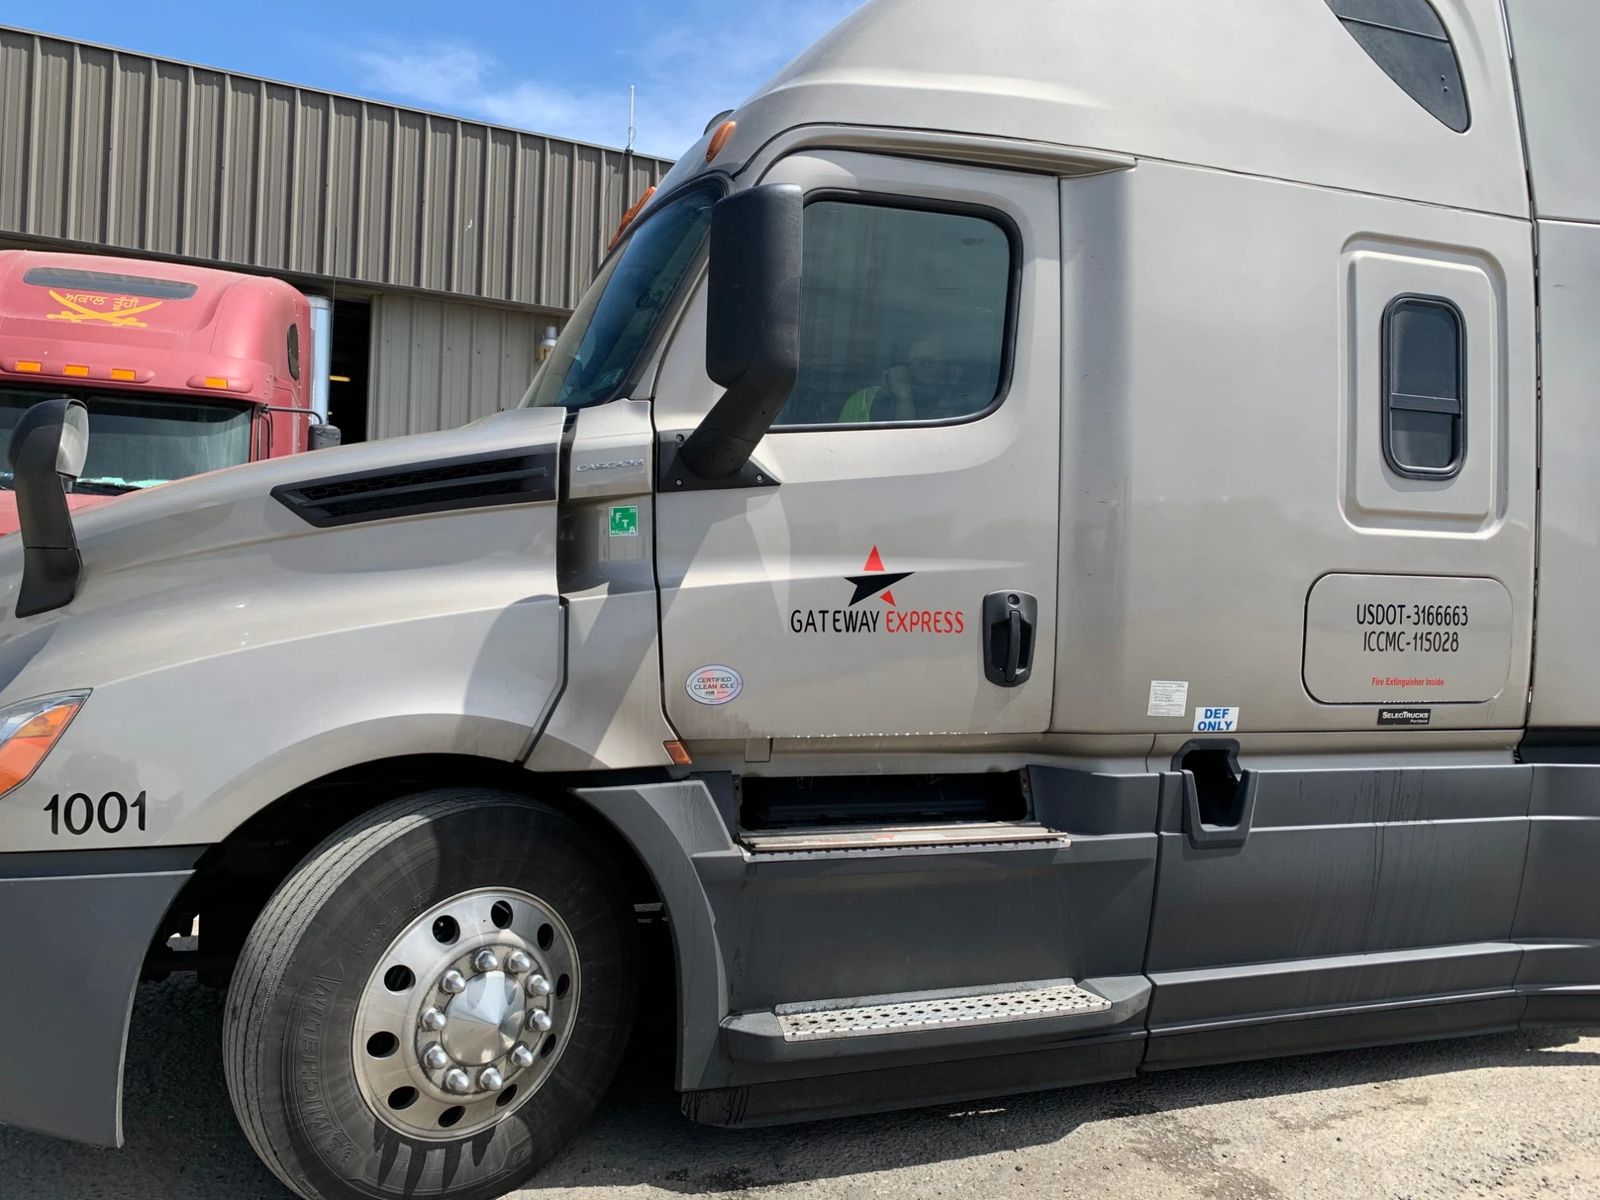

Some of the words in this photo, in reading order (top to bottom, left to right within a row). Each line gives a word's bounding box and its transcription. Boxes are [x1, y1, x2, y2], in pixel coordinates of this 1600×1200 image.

[65, 293, 109, 305] ਅਕਾਲ
[790, 609, 880, 634] GATEWAY
[885, 610, 964, 634] EXPRESS
[1356, 603, 1468, 626] USDOT-3166663
[1363, 630, 1459, 653] ICCMC-115028
[1371, 677, 1385, 686] Fire
[1385, 677, 1425, 688] Extinguisher
[1204, 708, 1230, 719] DEF
[1197, 720, 1233, 732] ONLY
[43, 790, 147, 836] 1001
